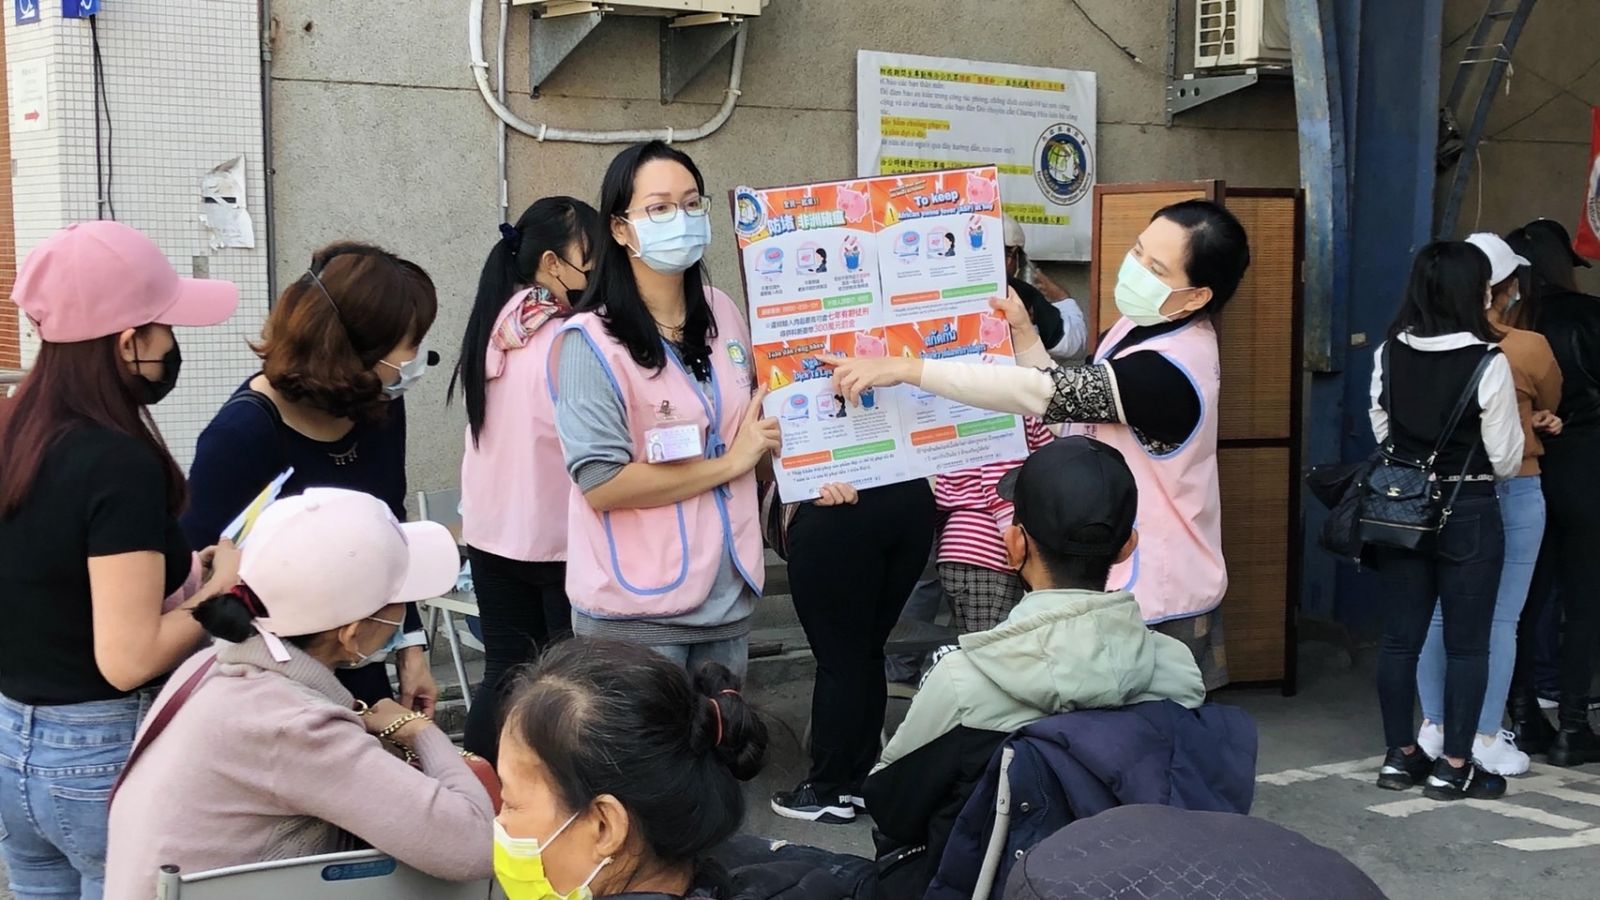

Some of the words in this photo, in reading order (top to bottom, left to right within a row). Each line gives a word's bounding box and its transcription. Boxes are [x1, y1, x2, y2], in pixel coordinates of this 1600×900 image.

[914, 195, 930, 207] To
[931, 190, 960, 205] keep
[768, 214, 796, 237] 防堵
